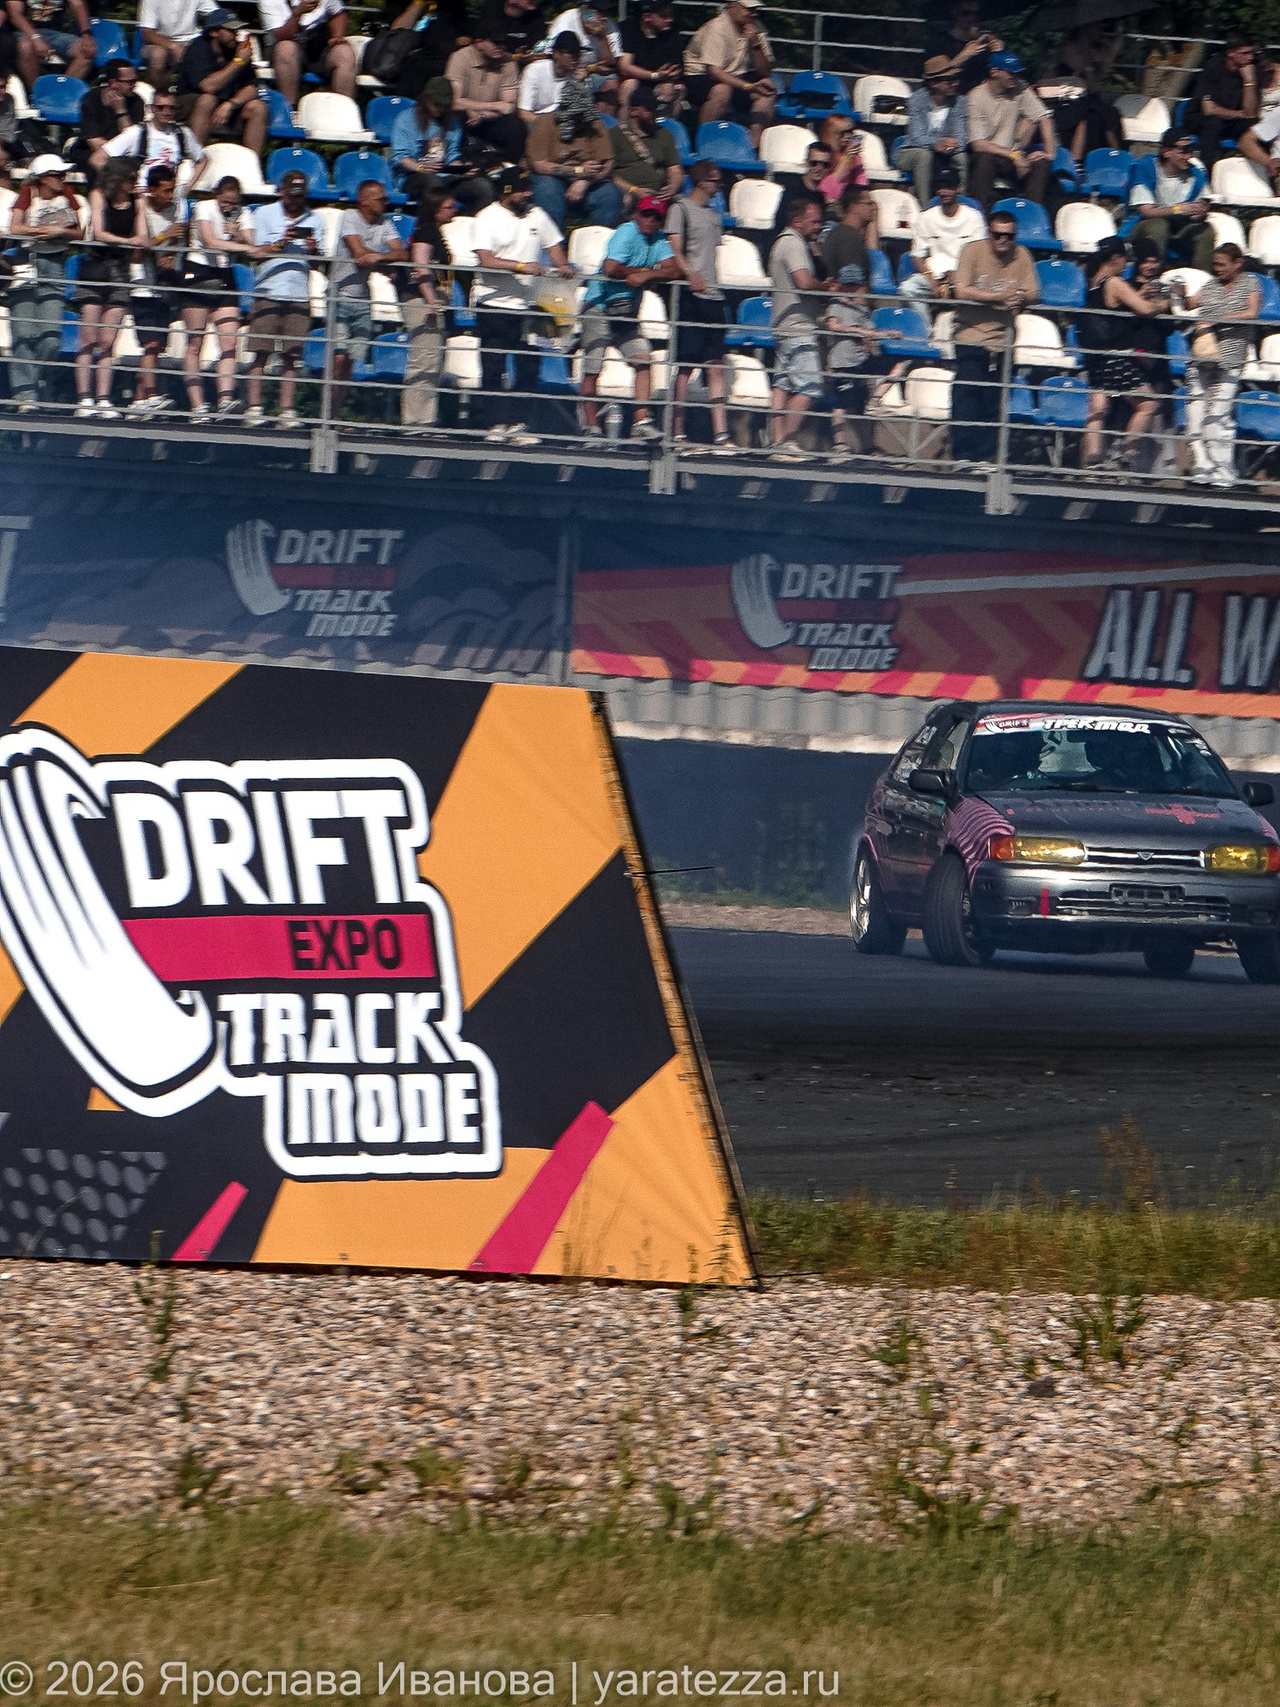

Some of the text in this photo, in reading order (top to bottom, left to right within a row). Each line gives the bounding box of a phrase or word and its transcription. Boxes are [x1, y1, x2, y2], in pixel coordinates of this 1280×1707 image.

[274, 528, 406, 565] DRIFT
[779, 563, 902, 599] DRIFT
[1082, 588, 1193, 685] ALL
[111, 789, 410, 909] DRIFT
[286, 919, 401, 972] EXPO
[218, 993, 457, 1066] TRACK
[286, 1073, 480, 1145] MODE
